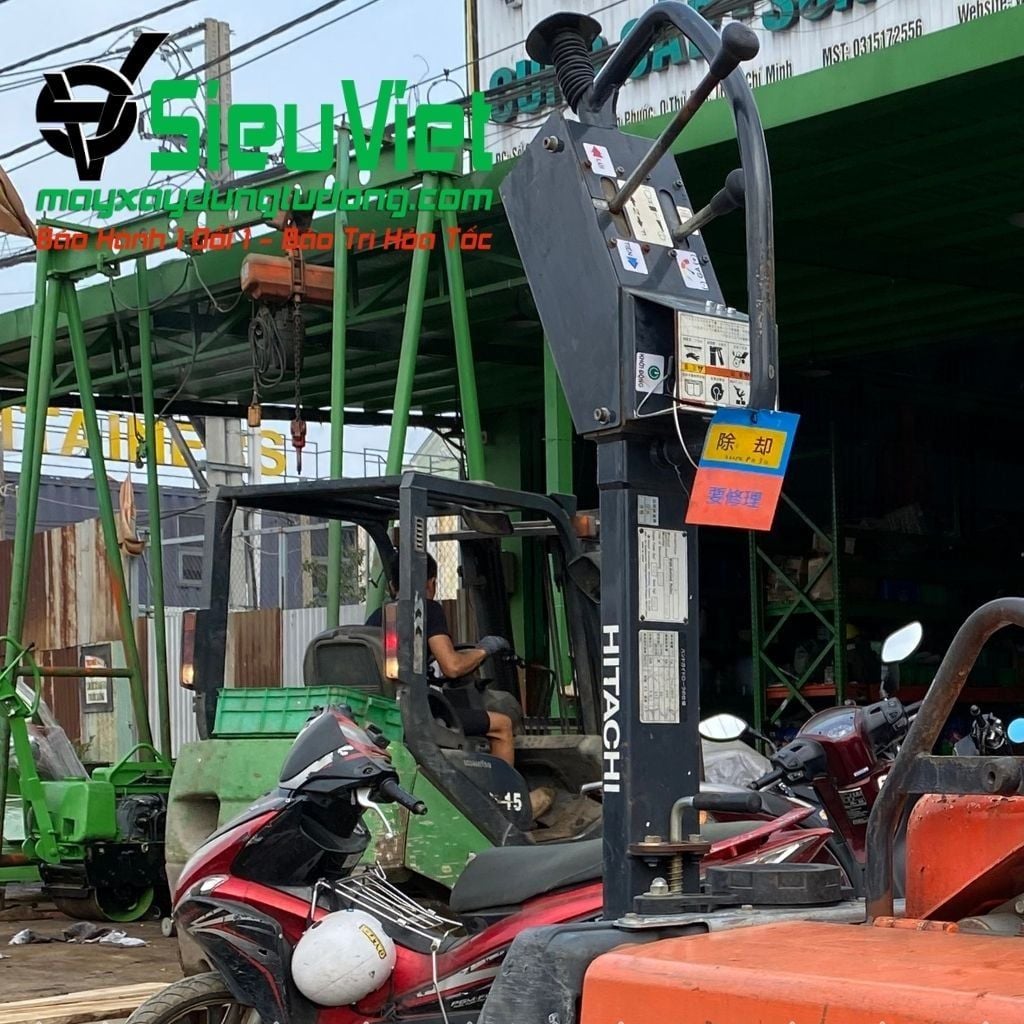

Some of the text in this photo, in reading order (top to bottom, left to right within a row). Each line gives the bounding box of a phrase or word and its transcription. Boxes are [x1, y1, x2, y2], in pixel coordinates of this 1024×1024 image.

[822, 18, 923, 67] MST: 0315172556
[765, 60, 793, 85] Minh
[602, 624, 621, 793] HITACHI
